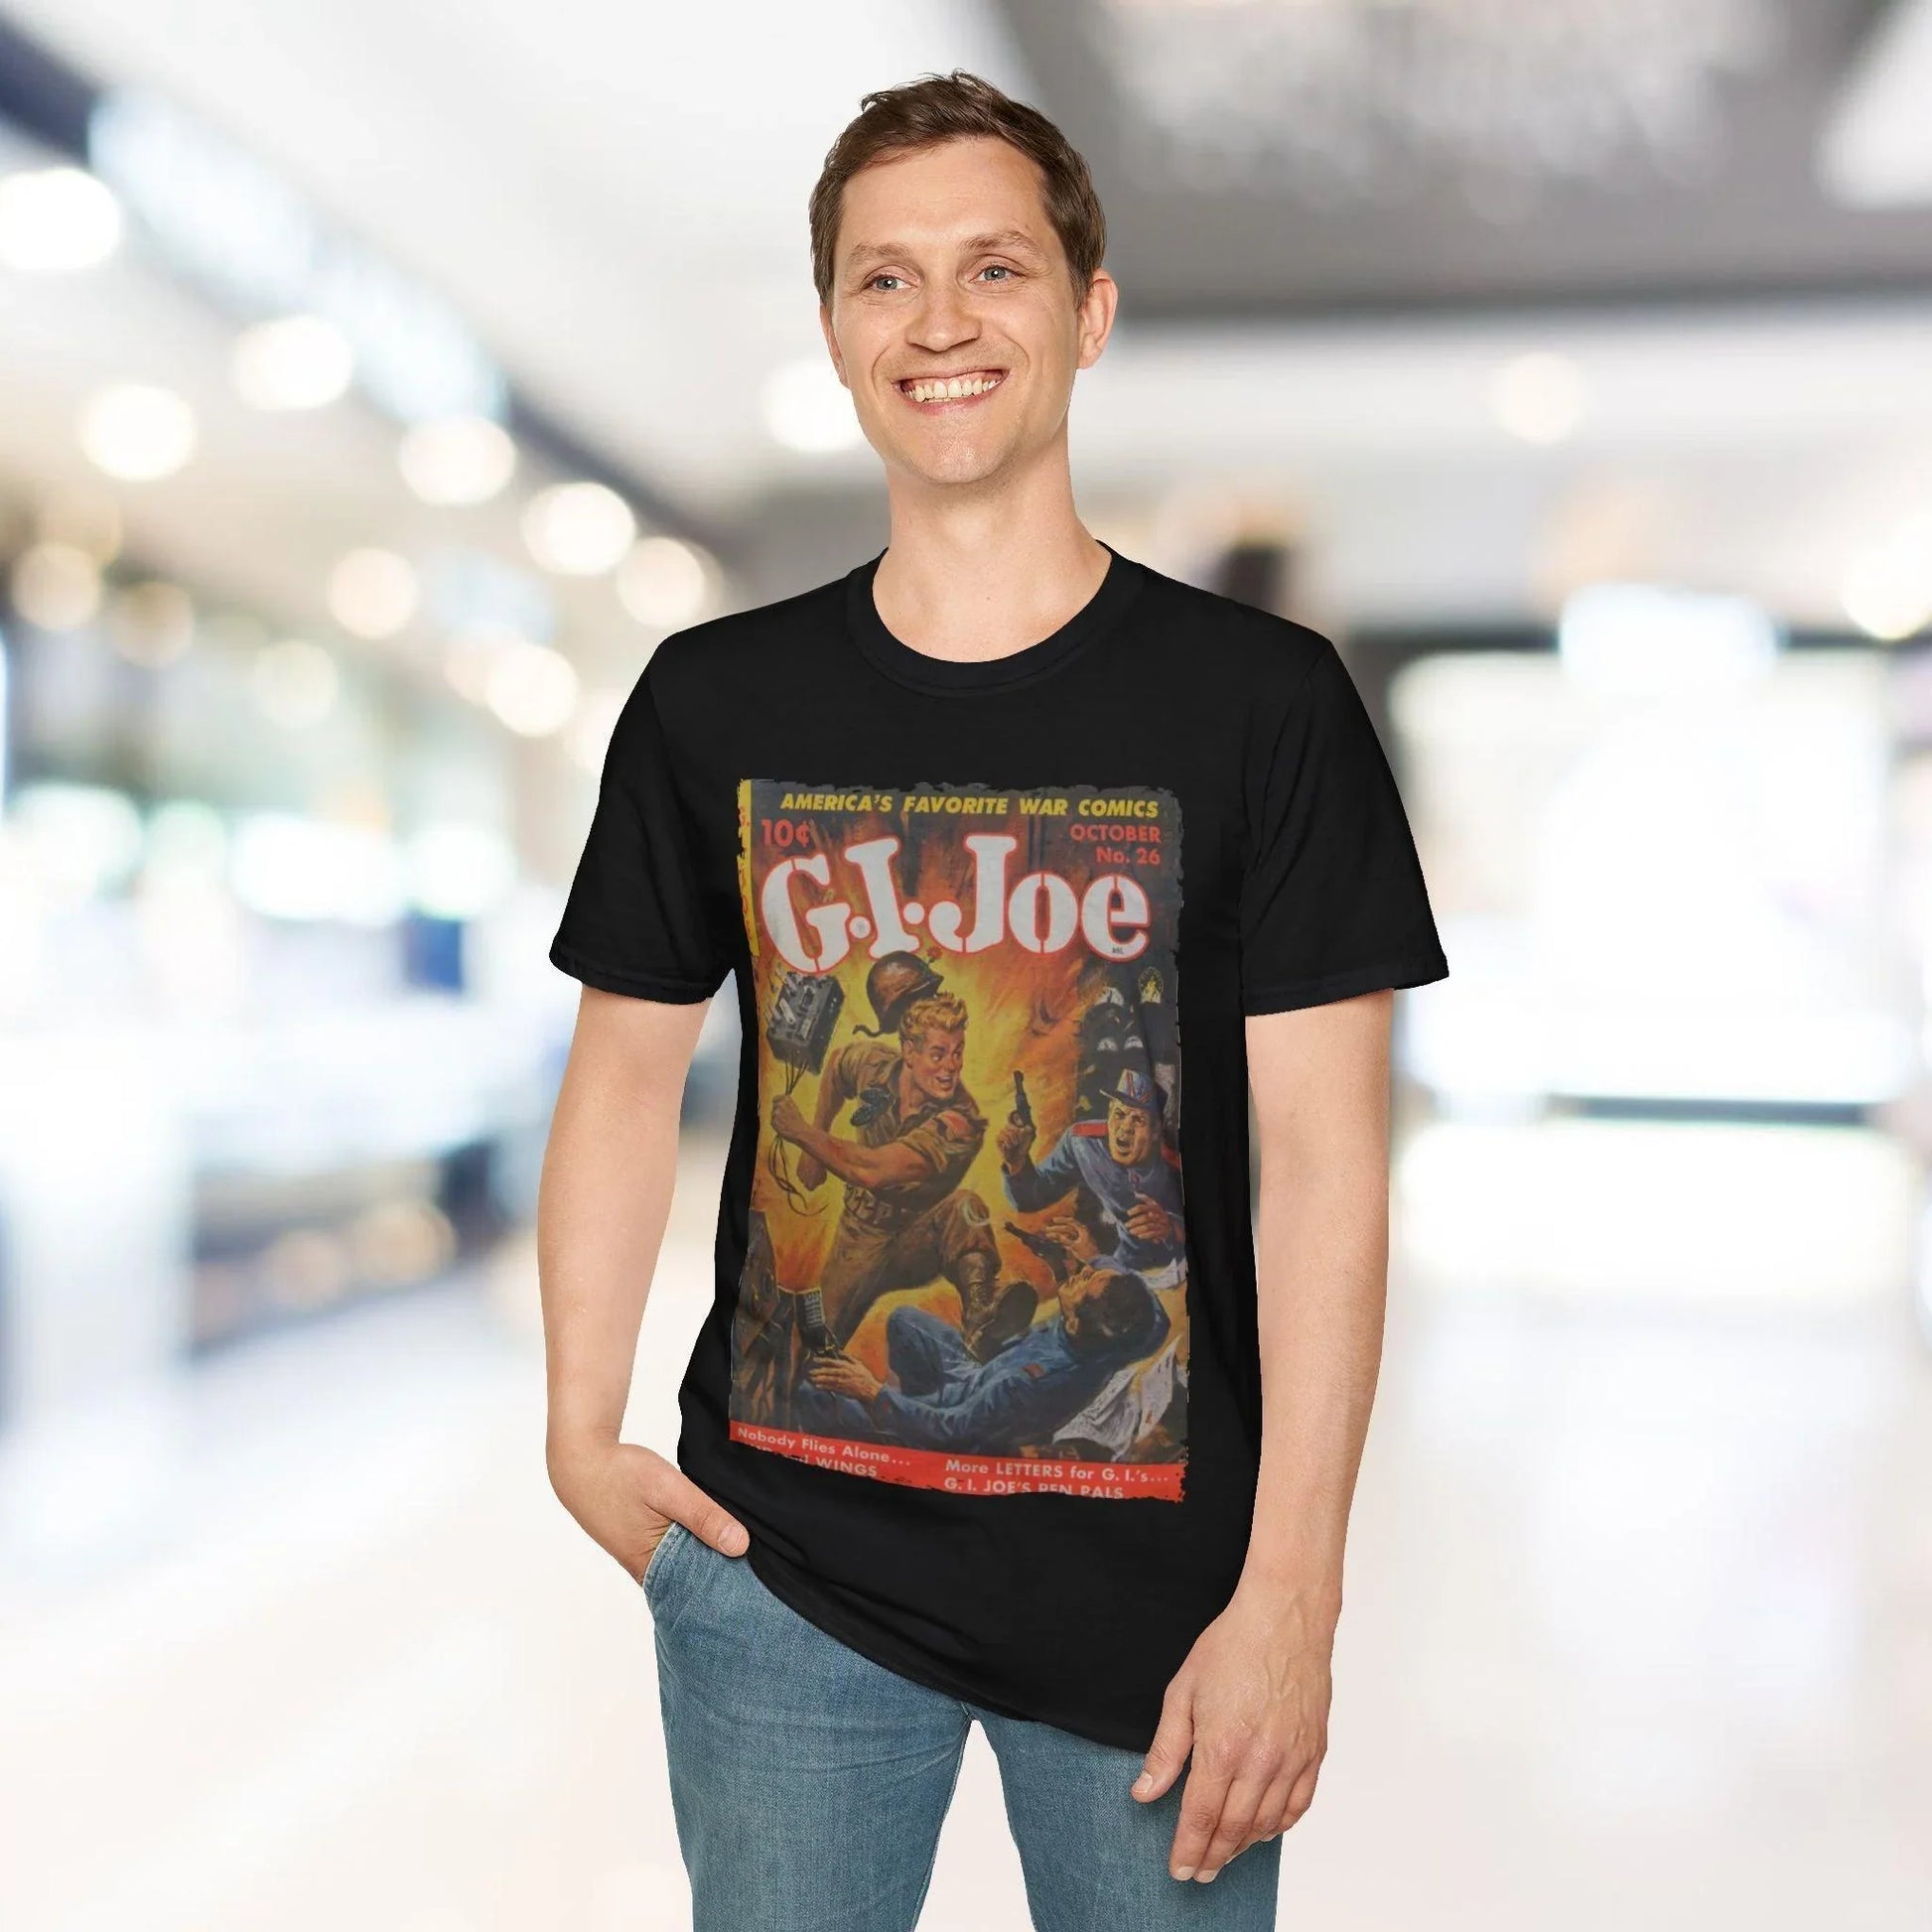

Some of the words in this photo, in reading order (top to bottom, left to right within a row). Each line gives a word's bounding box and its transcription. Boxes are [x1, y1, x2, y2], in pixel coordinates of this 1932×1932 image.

[780, 793, 893, 812] AMERICA'S
[902, 796, 1009, 815] FAVORITE
[1019, 798, 1068, 816] WAR
[1078, 799, 1159, 818] COMICS
[761, 818, 810, 847] 10¢
[1070, 824, 1161, 842] OCTOBER
[1096, 846, 1130, 864] No.
[1136, 847, 1161, 865] 26
[738, 1427, 795, 1449] Nobody
[802, 1439, 835, 1454] Flies
[815, 1456, 878, 1476] WINGS
[945, 1459, 989, 1473] More
[997, 1462, 1062, 1477] LETTERS
[1070, 1465, 1094, 1479] for
[983, 1479, 1032, 1493] JOE'S
